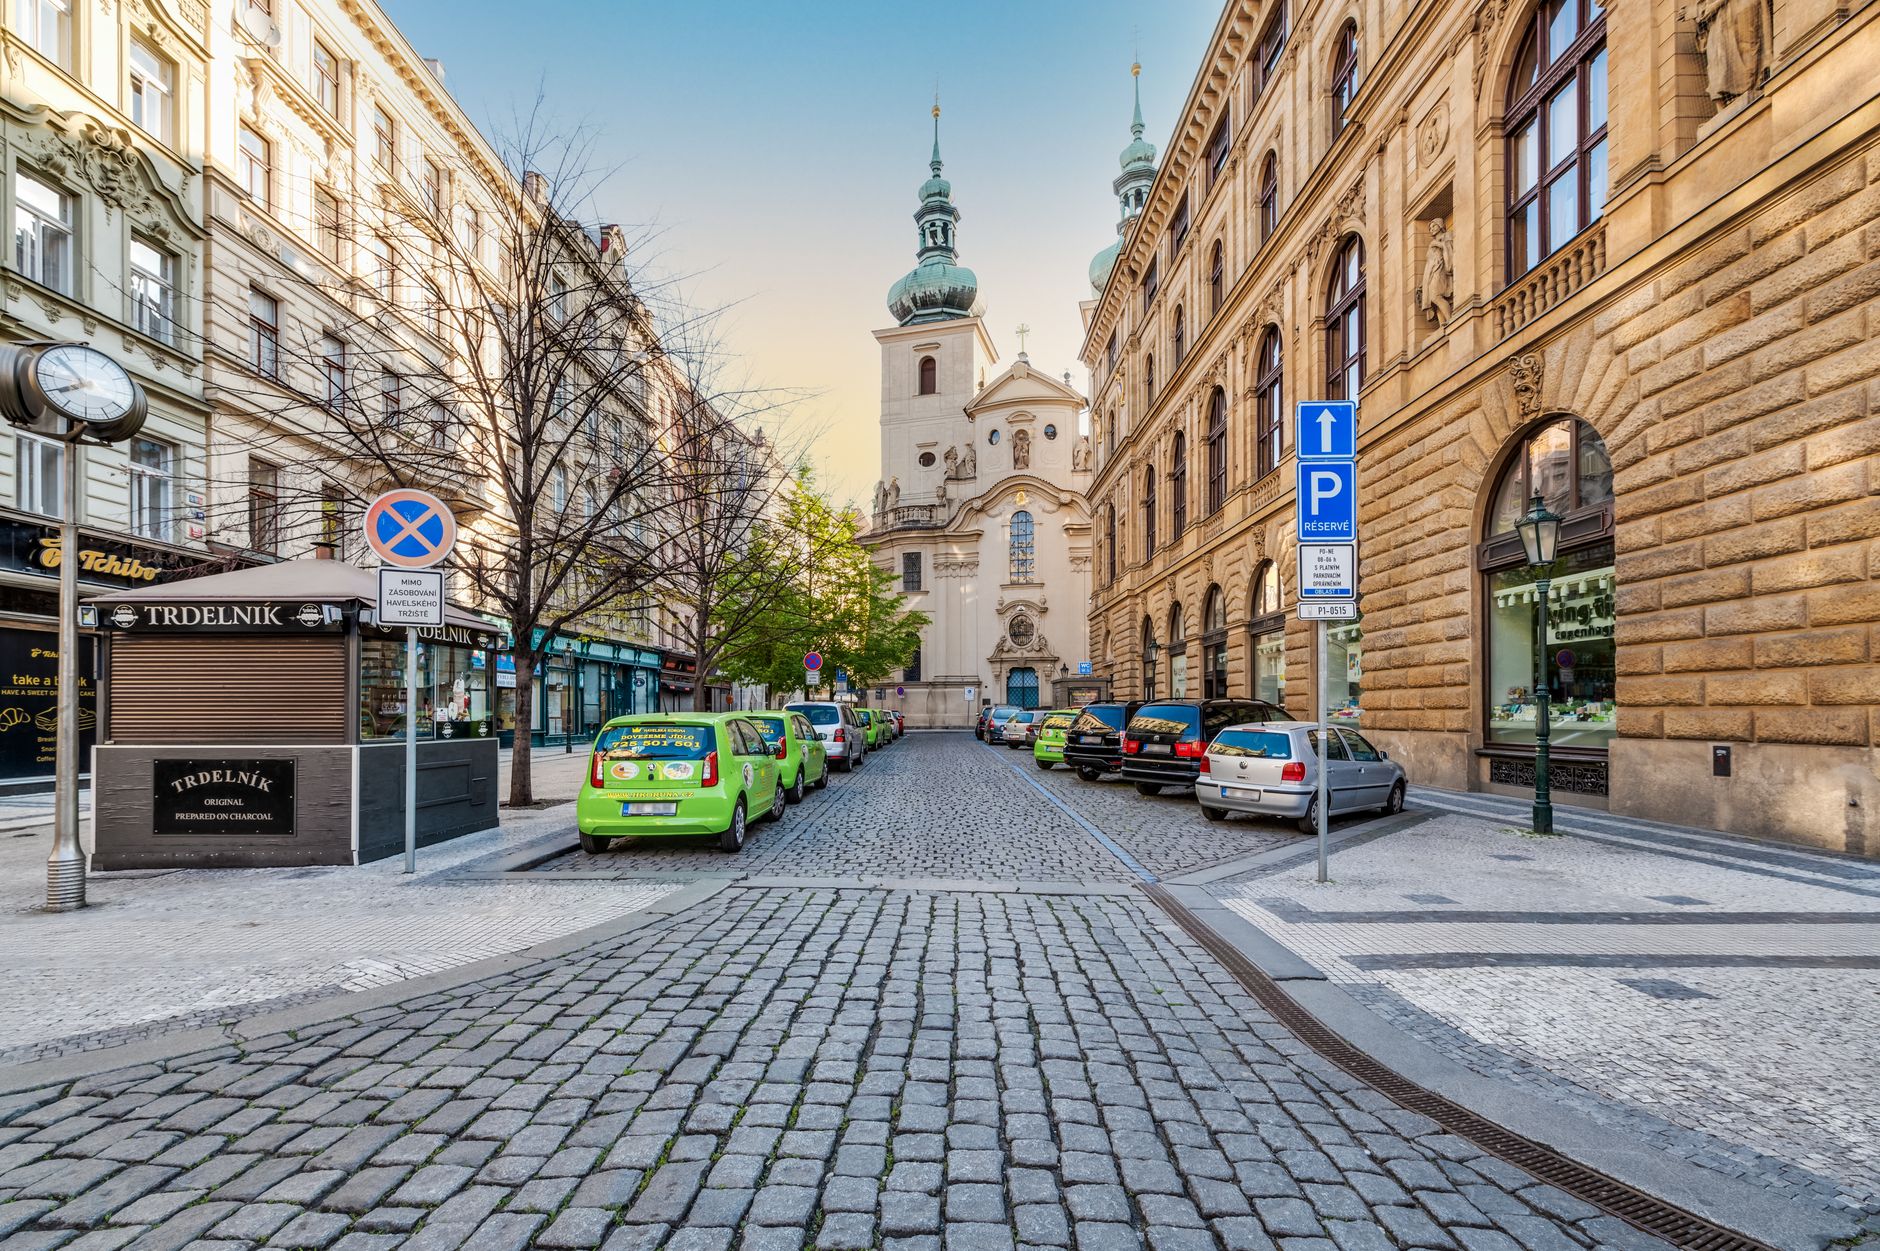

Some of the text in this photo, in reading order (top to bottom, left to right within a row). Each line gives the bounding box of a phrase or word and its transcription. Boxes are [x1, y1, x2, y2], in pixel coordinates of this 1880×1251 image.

[1311, 471, 1343, 516] P
[1304, 520, 1350, 531] RÉSERVÉ
[79, 549, 162, 581] Tchibo
[1319, 563, 1340, 571] PLATNÝM
[388, 588, 437, 597] ZÁSOBOVÁNÍ
[386, 599, 438, 607] HAVELSKÉHO
[144, 602, 284, 626] TRDELNÍK
[398, 609, 429, 617] TRŽIŠTĚ
[1318, 606, 1347, 615] P1-0515
[12, 674, 40, 686] take
[43, 677, 51, 686] a
[171, 770, 273, 793] TRDELNÍK
